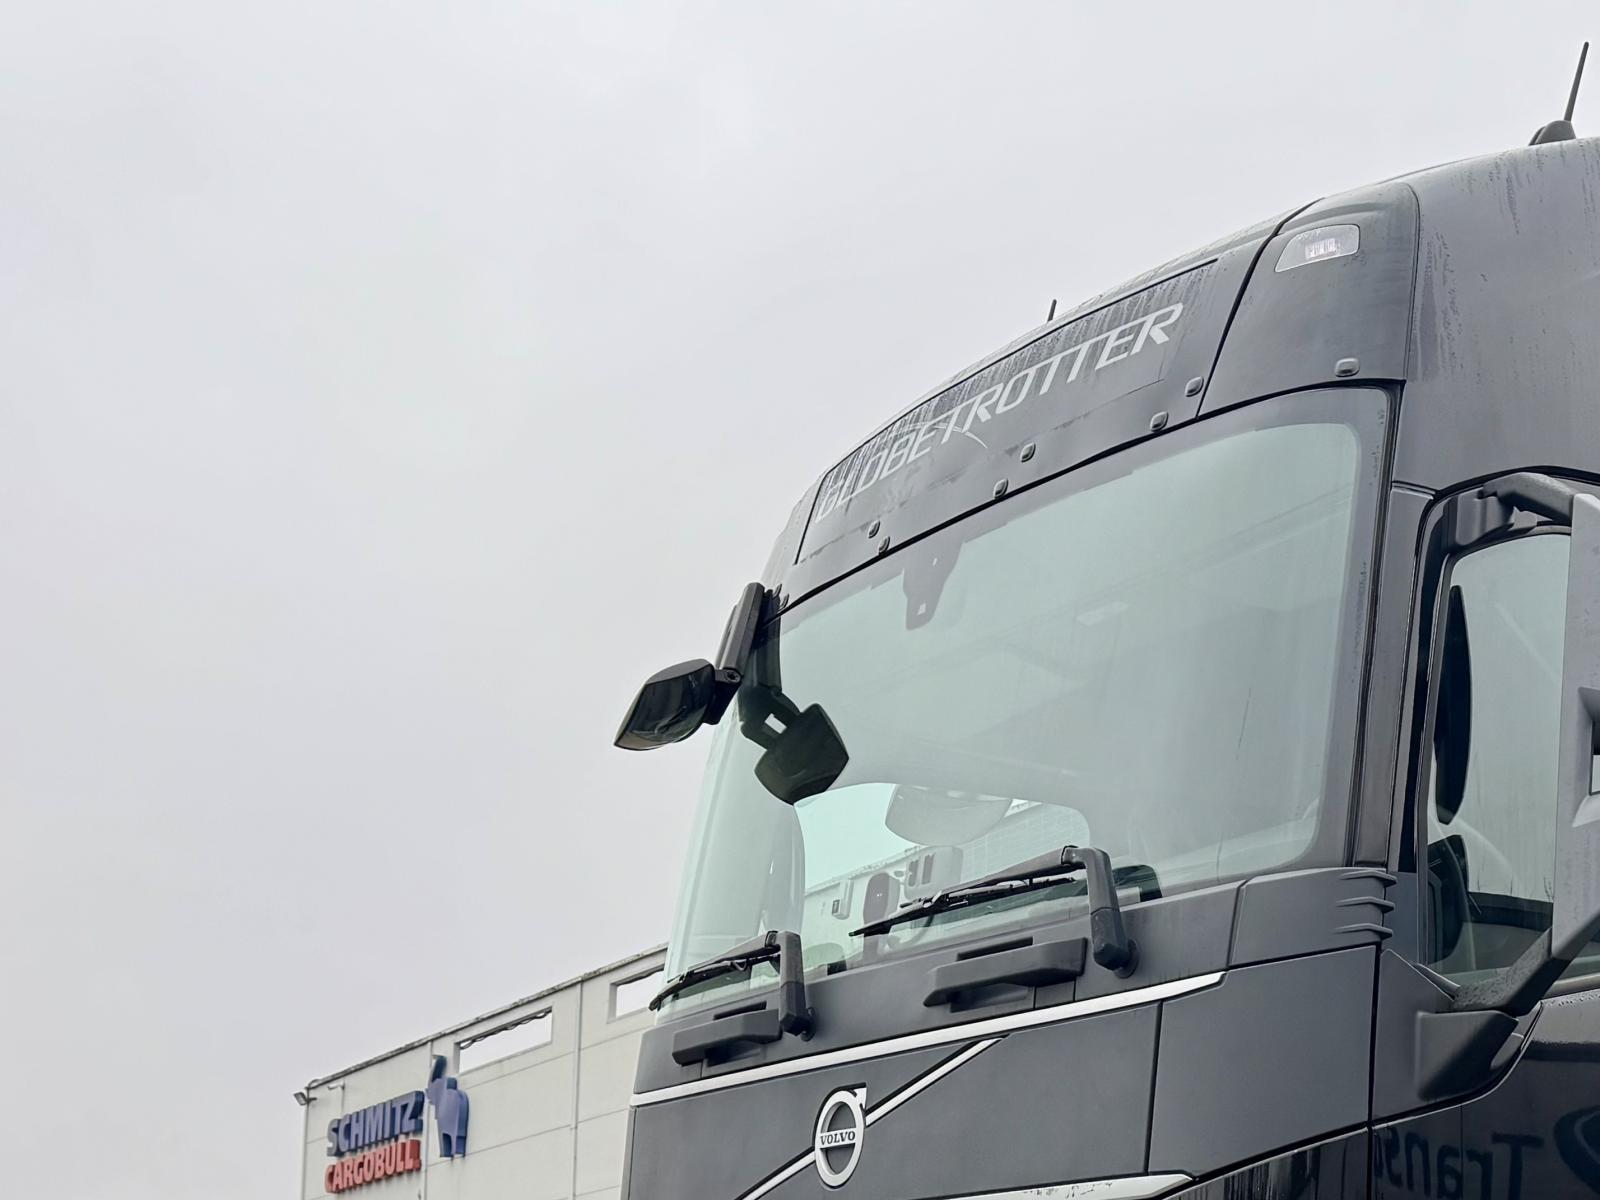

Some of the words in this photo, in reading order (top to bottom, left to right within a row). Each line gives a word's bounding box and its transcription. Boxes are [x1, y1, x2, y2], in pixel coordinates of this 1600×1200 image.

[815, 302, 1184, 523] GLOBETROTTER
[326, 1091, 425, 1157] SCHMITZ
[820, 1130, 856, 1146] VOLVO
[325, 1140, 422, 1193] CARGOBULL
